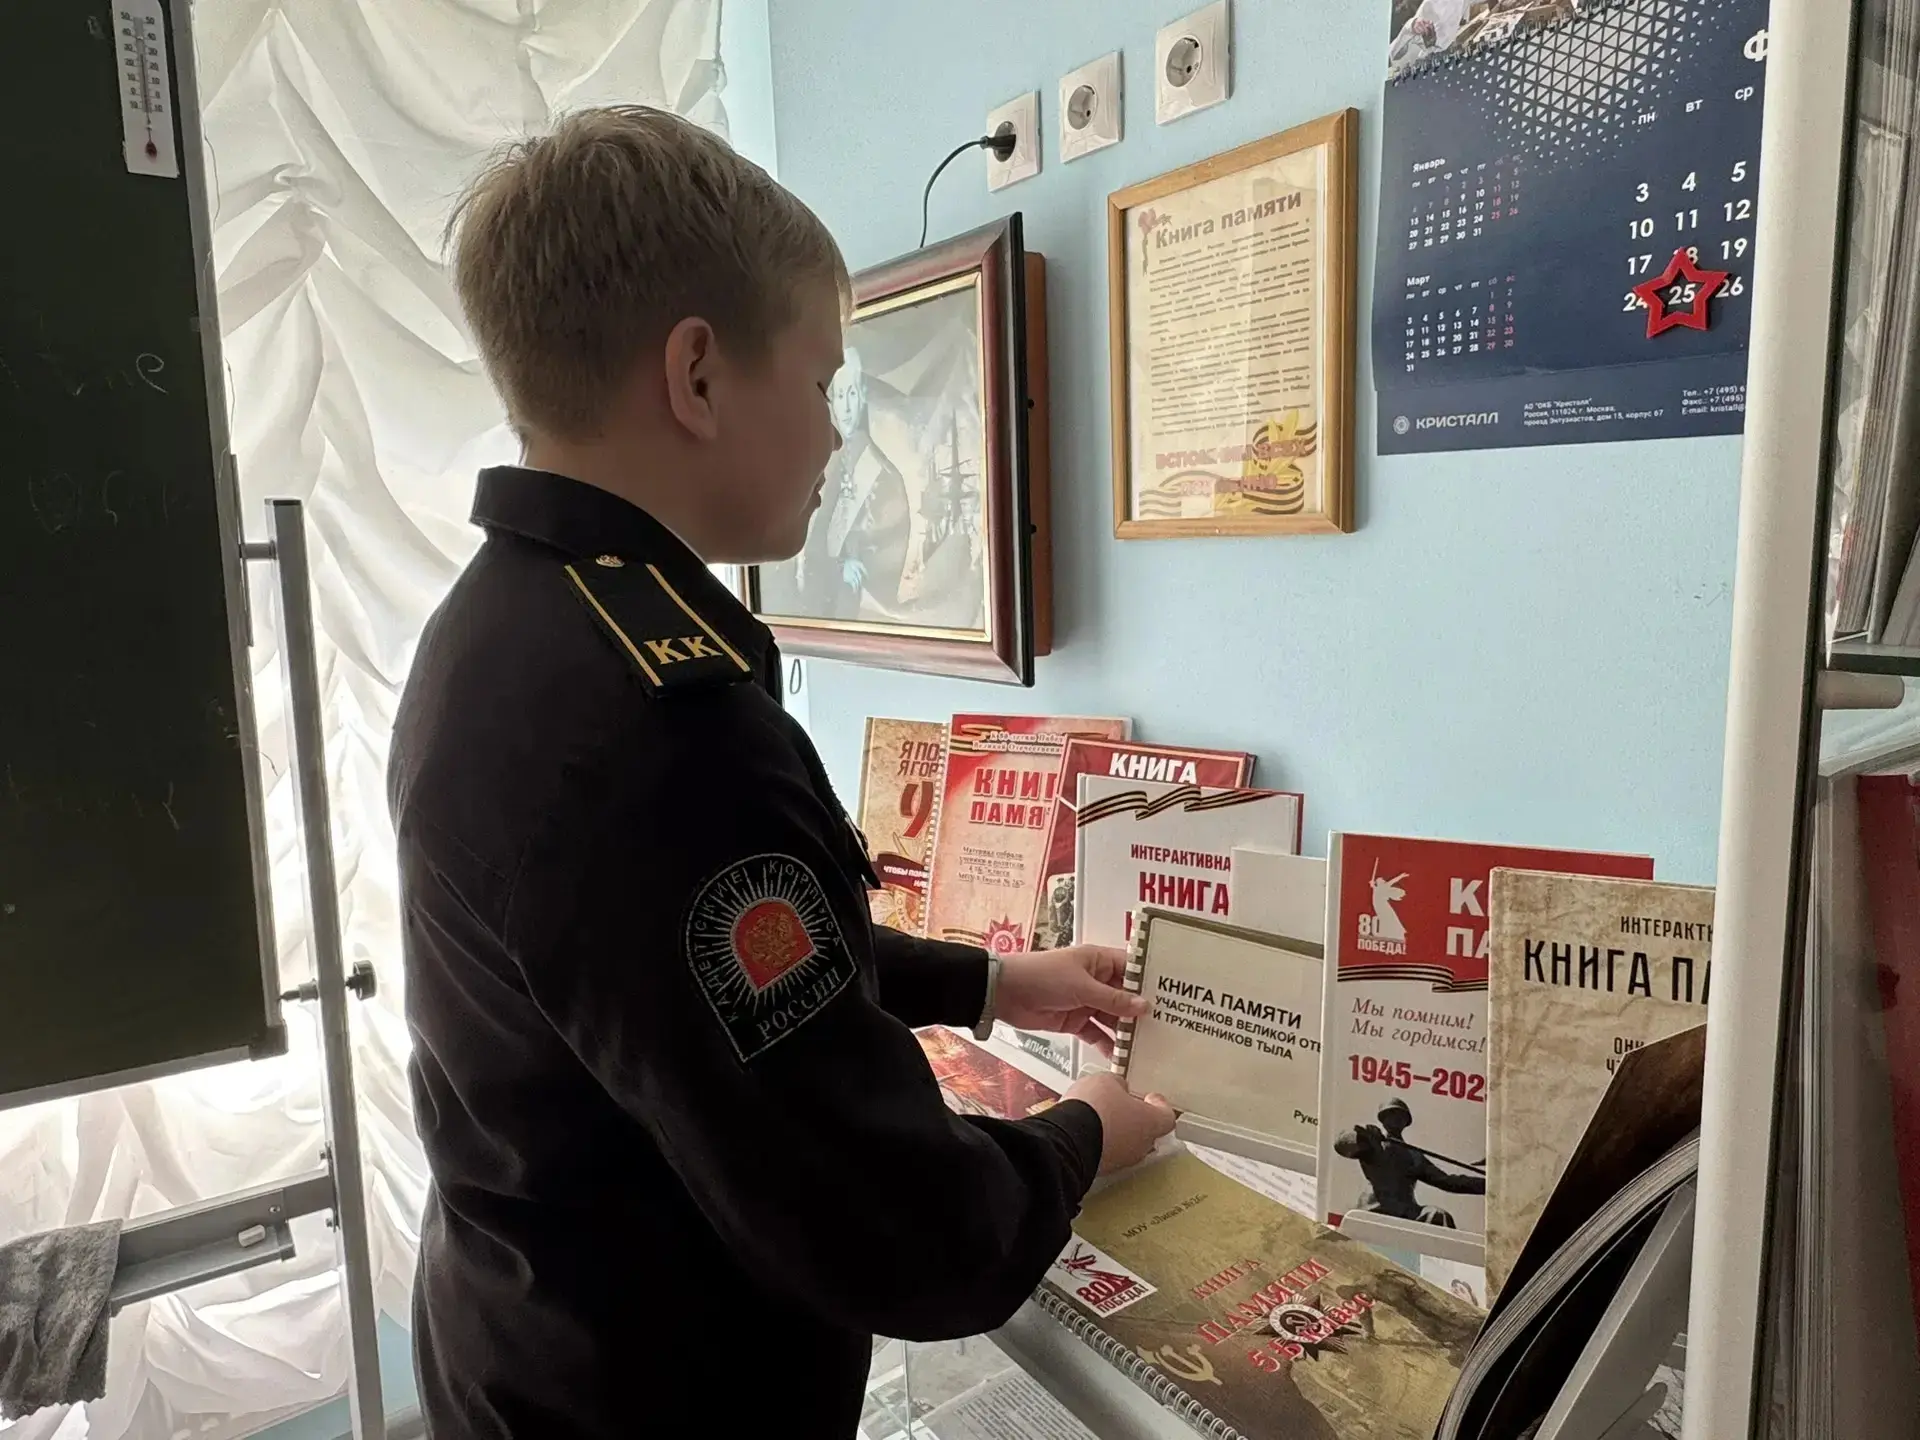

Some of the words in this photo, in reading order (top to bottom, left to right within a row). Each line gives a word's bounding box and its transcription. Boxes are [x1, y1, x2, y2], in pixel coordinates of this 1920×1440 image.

[1735, 86, 1753, 101] ср
[1636, 183, 1649, 202] 3
[1682, 172, 1696, 191] 4
[1731, 161, 1746, 182] 5
[1156, 219, 1214, 249] Книга
[1221, 192, 1301, 230] памяти
[1629, 218, 1653, 239] 10
[1675, 209, 1698, 231] 11
[1724, 199, 1750, 221] 12
[1628, 255, 1652, 275] 17
[1721, 238, 1747, 260] 19
[1407, 276, 1430, 286] Март
[1669, 284, 1696, 305] 25
[1715, 277, 1743, 298] 26
[1470, 319, 1479, 327] 14
[1406, 364, 1414, 372] 31
[1416, 412, 1499, 429] КРИСТАЛЛ
[644, 635, 724, 665] КК
[899, 740, 914, 759] Я
[898, 760, 910, 775] Я
[1109, 752, 1198, 784] КНИГА
[970, 801, 1051, 826] ПАМЯ
[1131, 844, 1231, 872] ИНТЕРАКТИВНА
[1139, 872, 1229, 915] КНИГА
[1359, 913, 1380, 937] 80
[1358, 939, 1406, 955] ПОБЕДА!
[1524, 939, 1651, 997] КНИГА
[757, 967, 841, 1042] РОССИИ
[1158, 976, 1216, 1005] КНИГА
[1220, 993, 1301, 1029] ПАМЯТИ
[1352, 998, 1384, 1016] Мы
[1392, 1007, 1474, 1030] помним!
[1153, 1010, 1161, 1020] И
[1165, 1013, 1252, 1047] ТРУЖЕННИКОВ
[1257, 1039, 1293, 1060] ТЫЛА
[1155, 996, 1233, 1027] УЧАСТНИКОВ
[1237, 1020, 1296, 1045] ВЕЛИКОЙ
[1351, 1018, 1384, 1037] Мы
[1392, 1029, 1487, 1053] гордимся!
[1349, 1054, 1487, 1102] 1945–202
[1122, 1223, 1147, 1238] МОУ
[1193, 1258, 1262, 1299] КНИГА
[1096, 1284, 1149, 1313] ПОБЕДА!
[1196, 1256, 1333, 1346] ПАМЯТИ
[1248, 1350, 1280, 1372] 5
[1299, 1292, 1376, 1344] класс
